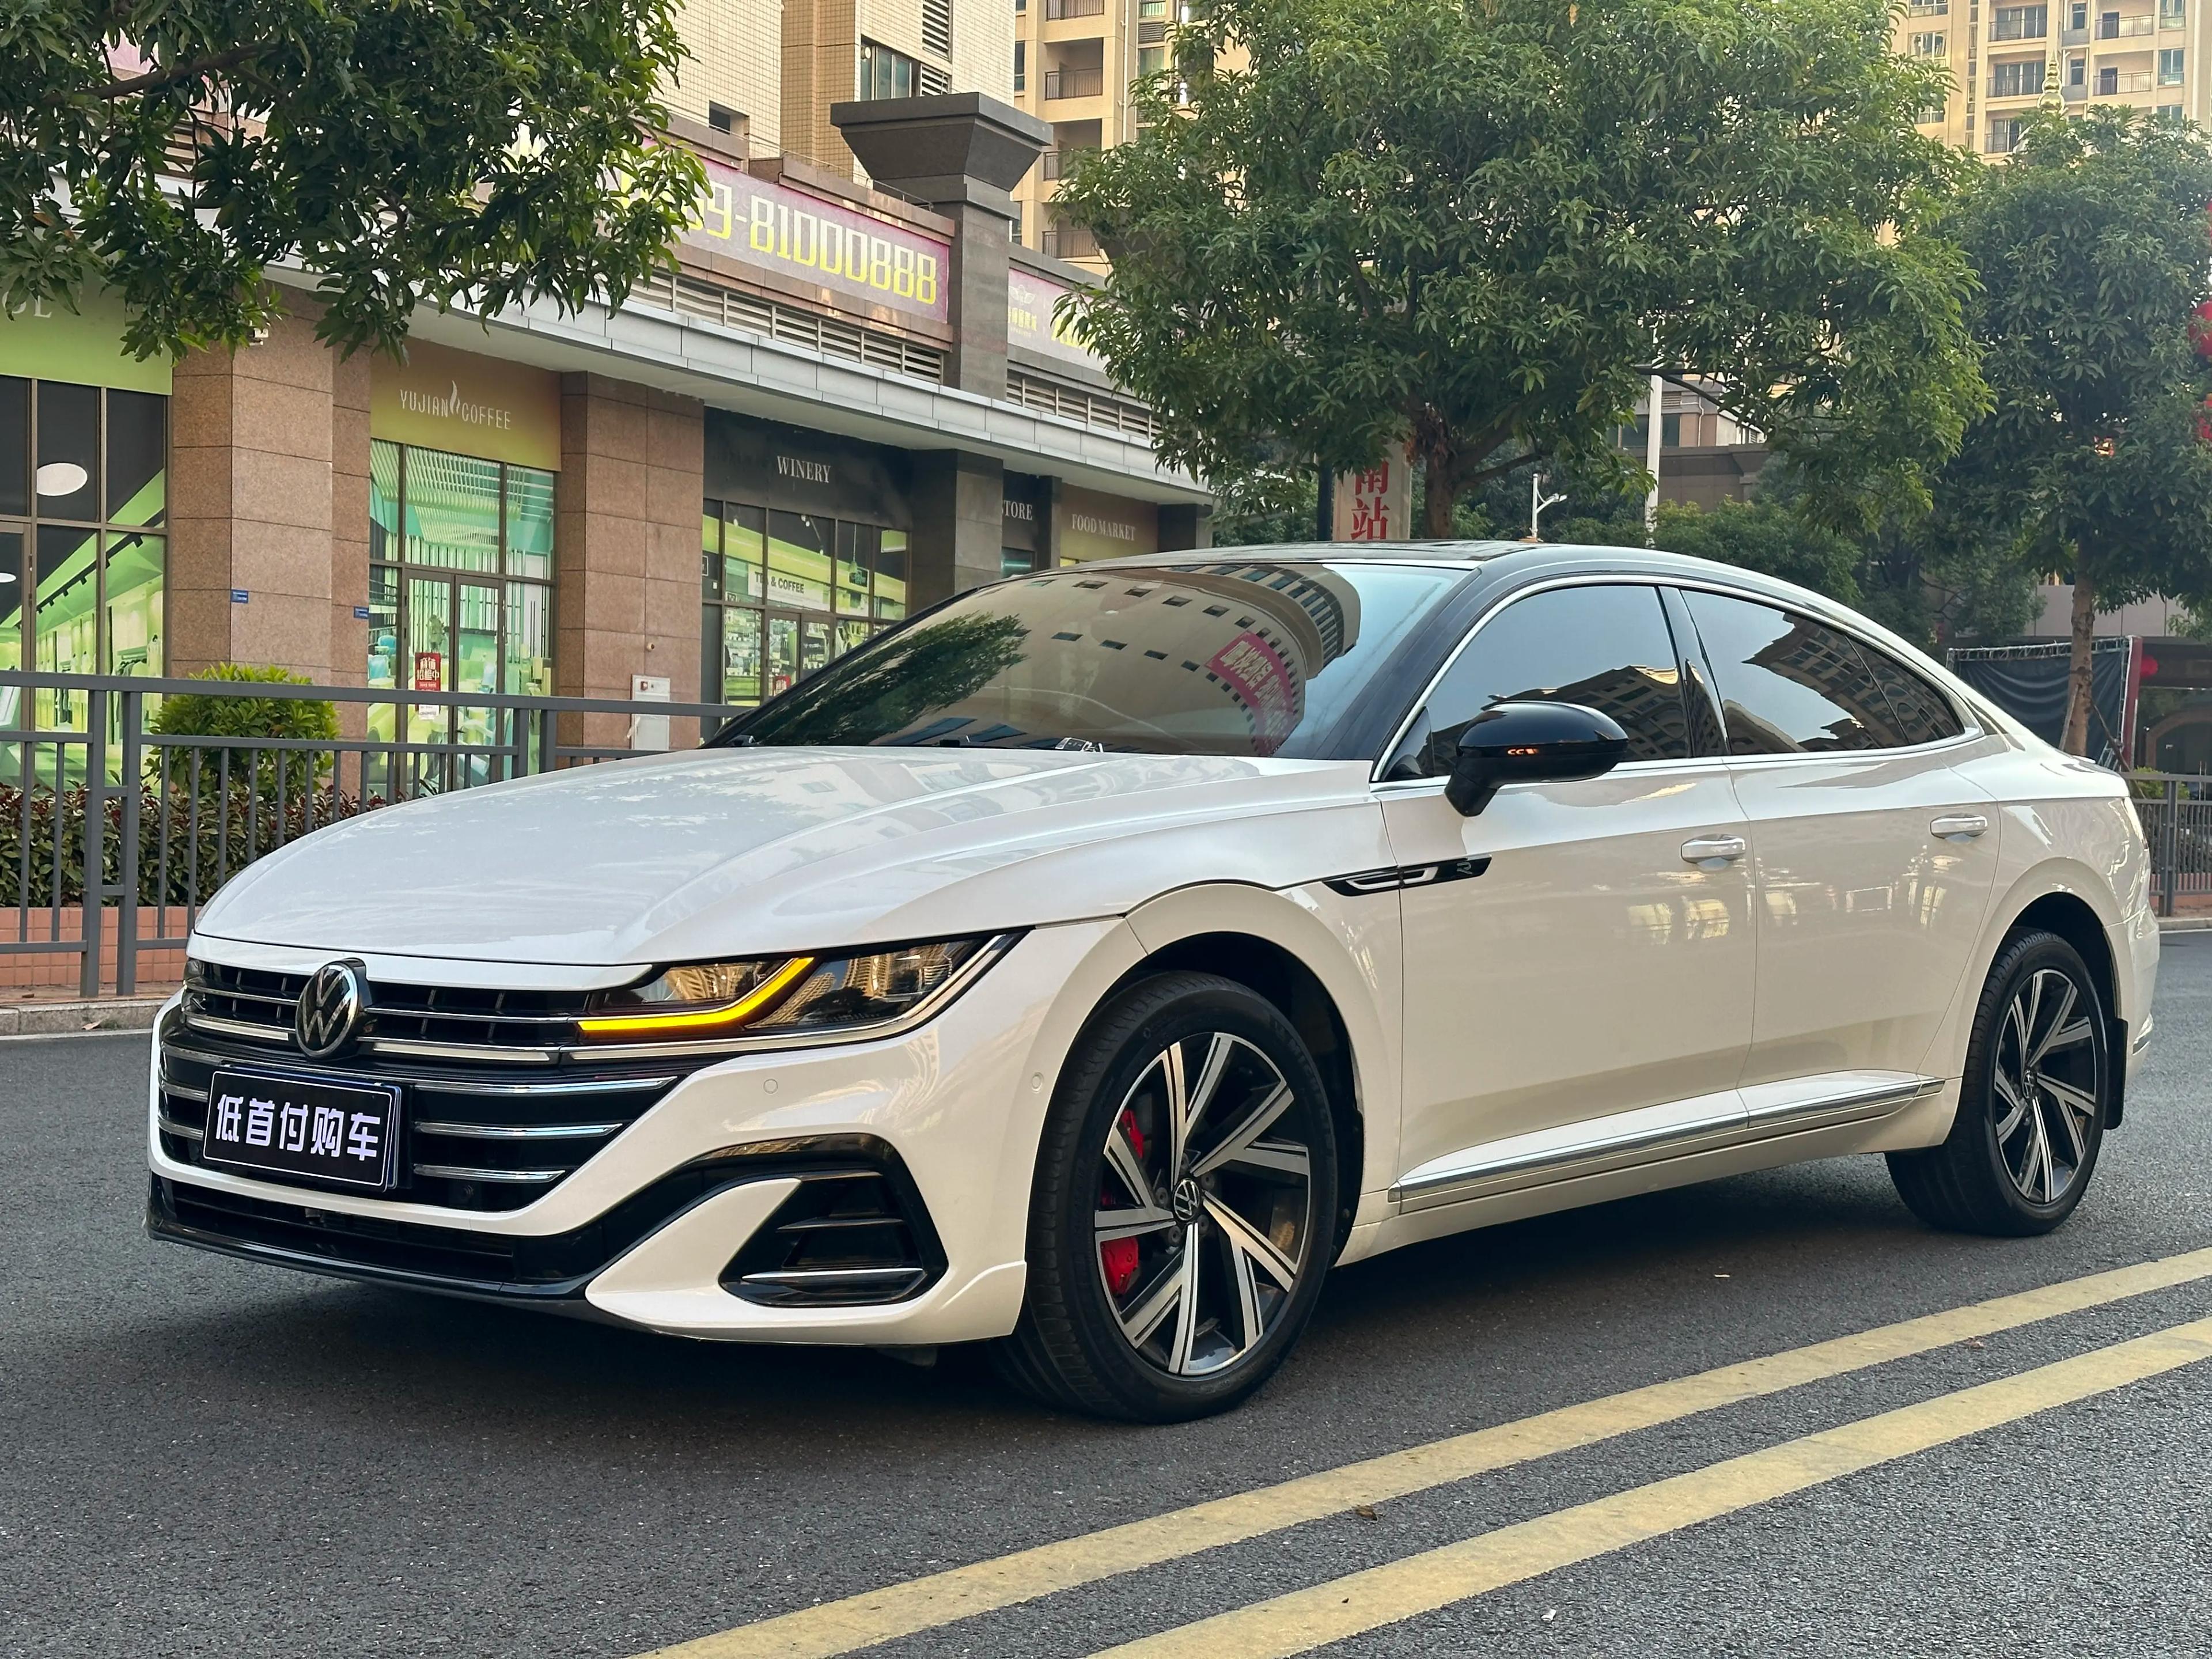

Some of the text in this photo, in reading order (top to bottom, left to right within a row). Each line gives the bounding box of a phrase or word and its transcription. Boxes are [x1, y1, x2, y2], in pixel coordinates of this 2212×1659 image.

[400, 389, 511, 430] YUJIAN COFFEE
[777, 456, 831, 483] WINERY
[1002, 500, 1033, 521] TORE
[1071, 514, 1135, 541] FOOD MARKET
[771, 576, 777, 586] &
[778, 578, 805, 594] COFFEE
[215, 1094, 381, 1161] 低首付购车
